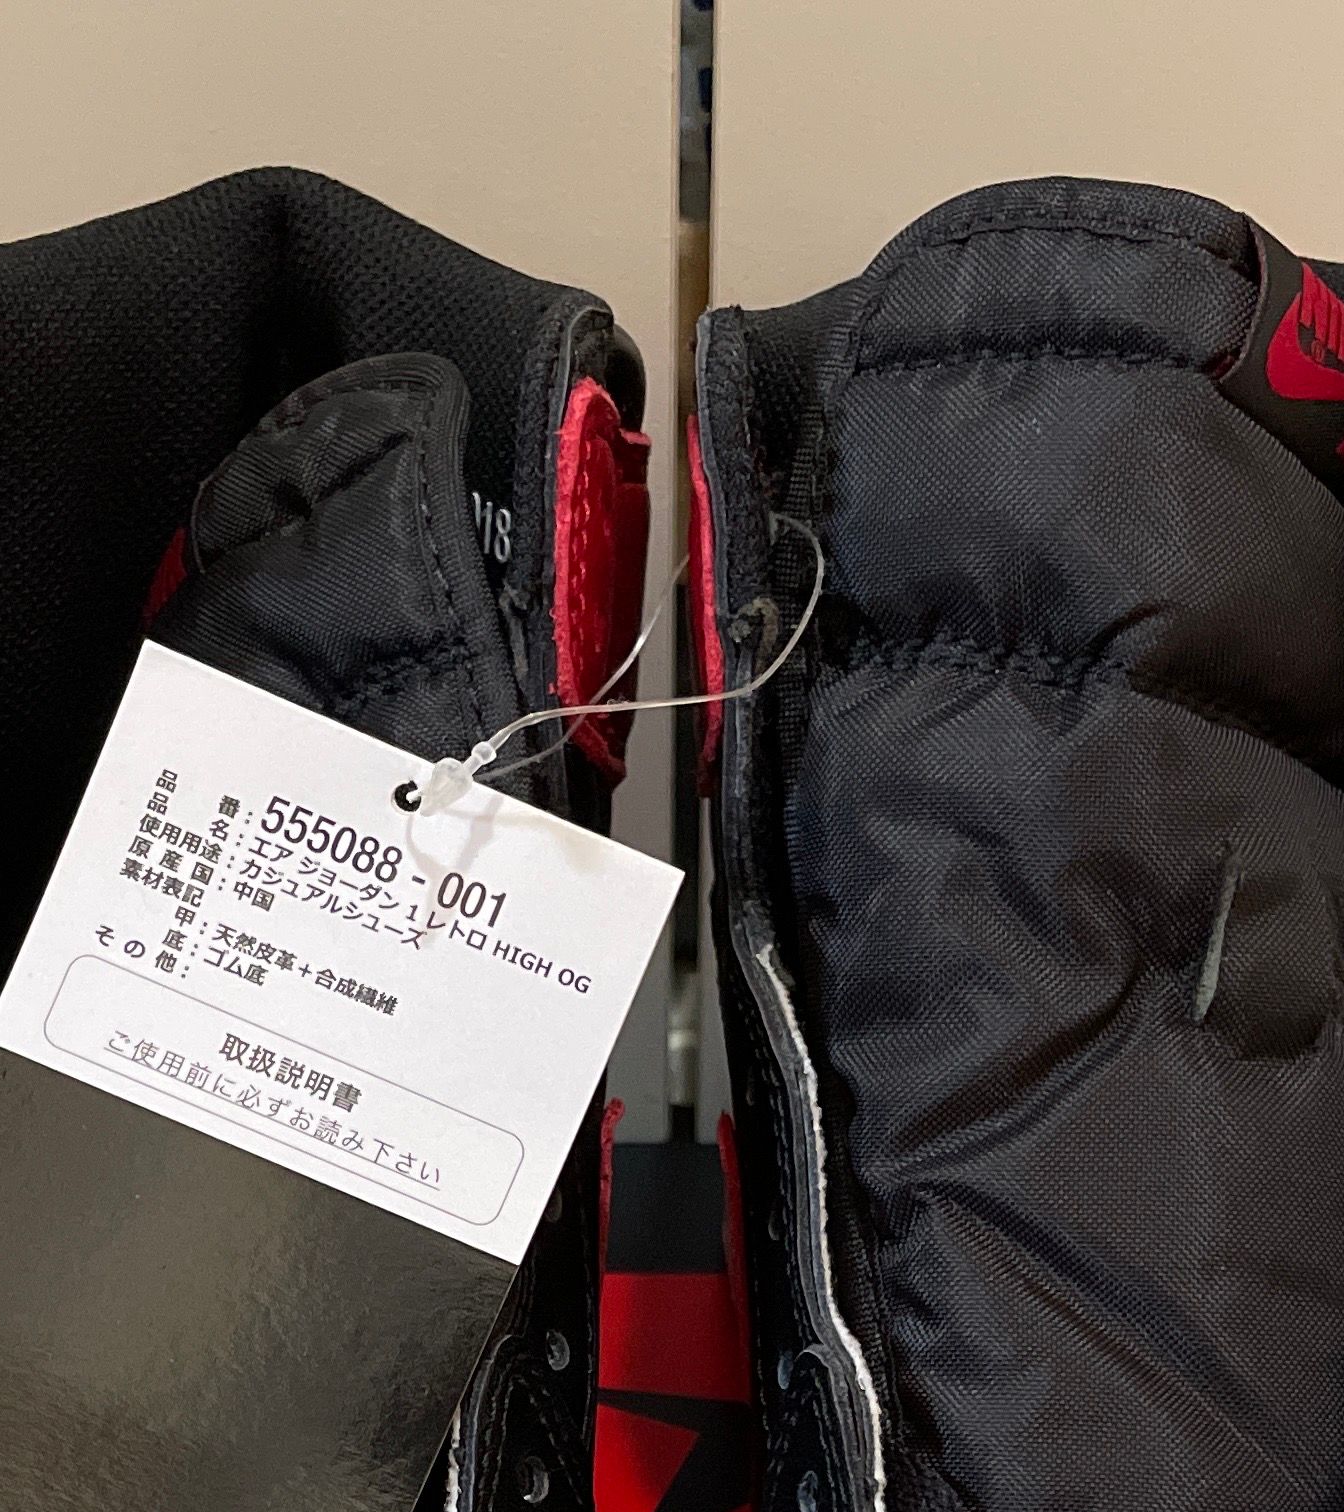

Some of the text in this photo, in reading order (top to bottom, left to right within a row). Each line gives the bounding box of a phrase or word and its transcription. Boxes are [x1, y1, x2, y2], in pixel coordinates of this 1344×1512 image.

[118, 856, 205, 908] 素材表記
[145, 790, 170, 816] 品
[246, 834, 295, 863] エア
[296, 854, 400, 910] ジョーダン
[404, 903, 419, 922] 1
[424, 909, 488, 951] レトロ
[490, 938, 554, 979] HIGH
[556, 967, 592, 994] OG
[154, 767, 178, 794] 品
[259, 794, 403, 884] 555088
[435, 870, 507, 929] 001
[231, 879, 276, 913] 中国
[237, 857, 428, 951] カジュアルシューズ
[202, 944, 269, 987] ゴム底
[106, 1031, 440, 1185] ご使用前に必ずお読み下さい
[217, 1031, 363, 1113] 取扱説明書
